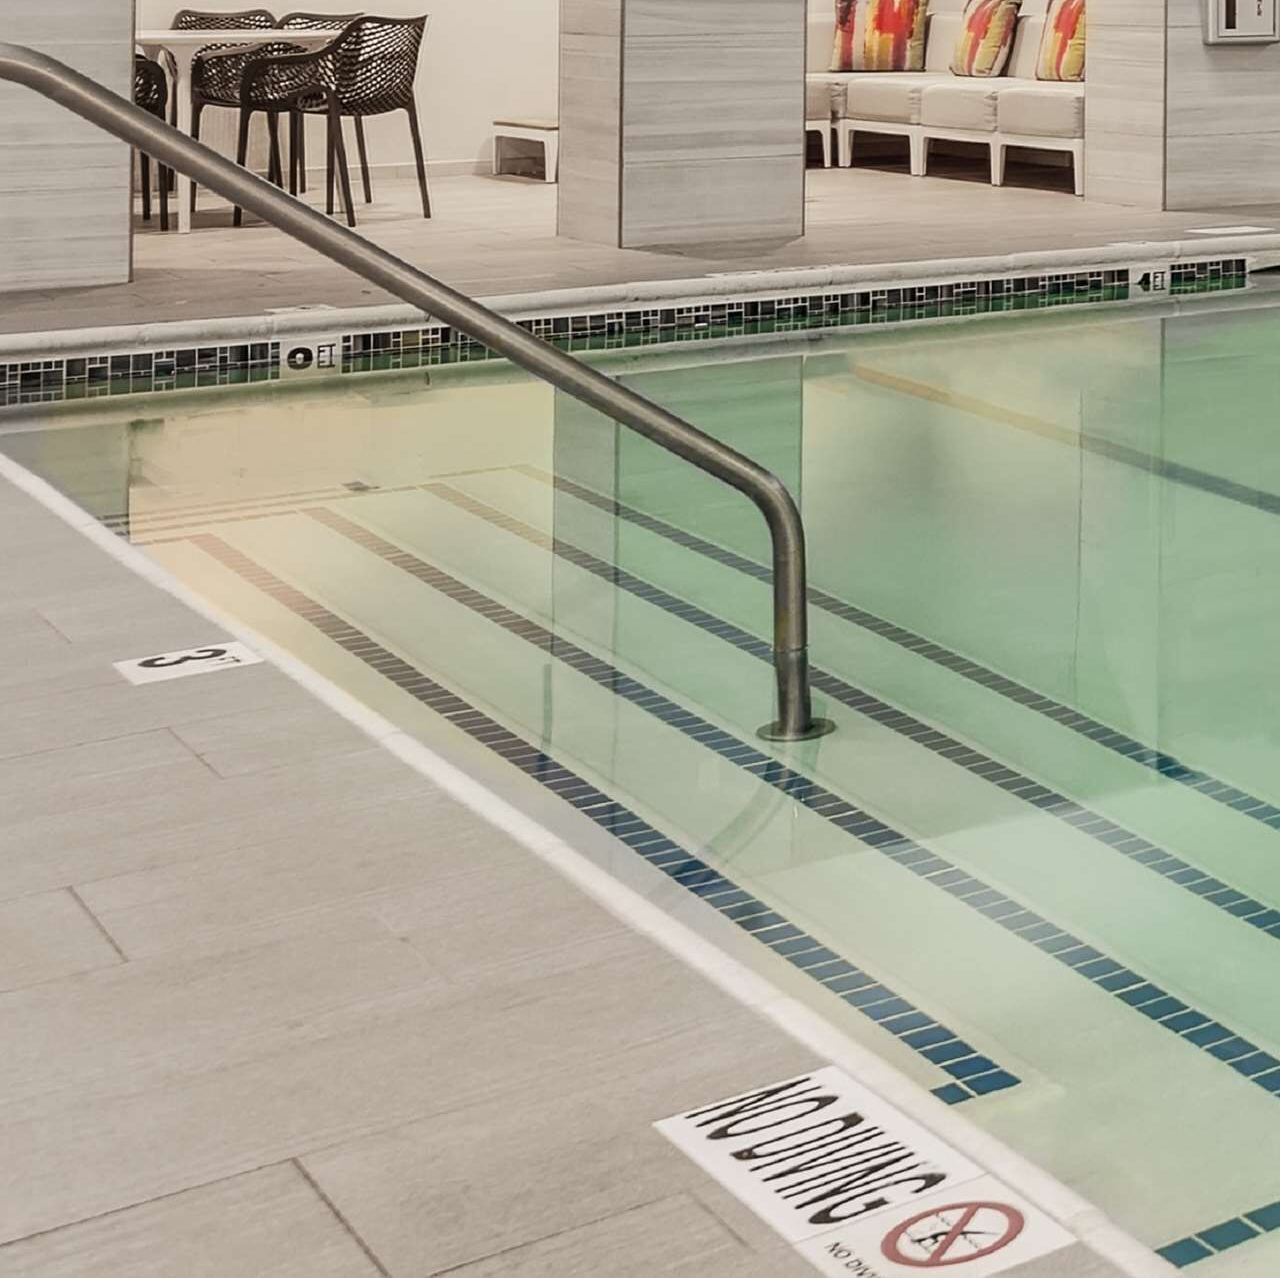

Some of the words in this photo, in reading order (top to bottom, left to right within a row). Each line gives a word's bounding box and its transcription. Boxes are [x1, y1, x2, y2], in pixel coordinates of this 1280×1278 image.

[137, 648, 228, 668] 3
[684, 1076, 841, 1141] NO
[730, 1111, 948, 1225] DIVING
[823, 1241, 856, 1259] NO
